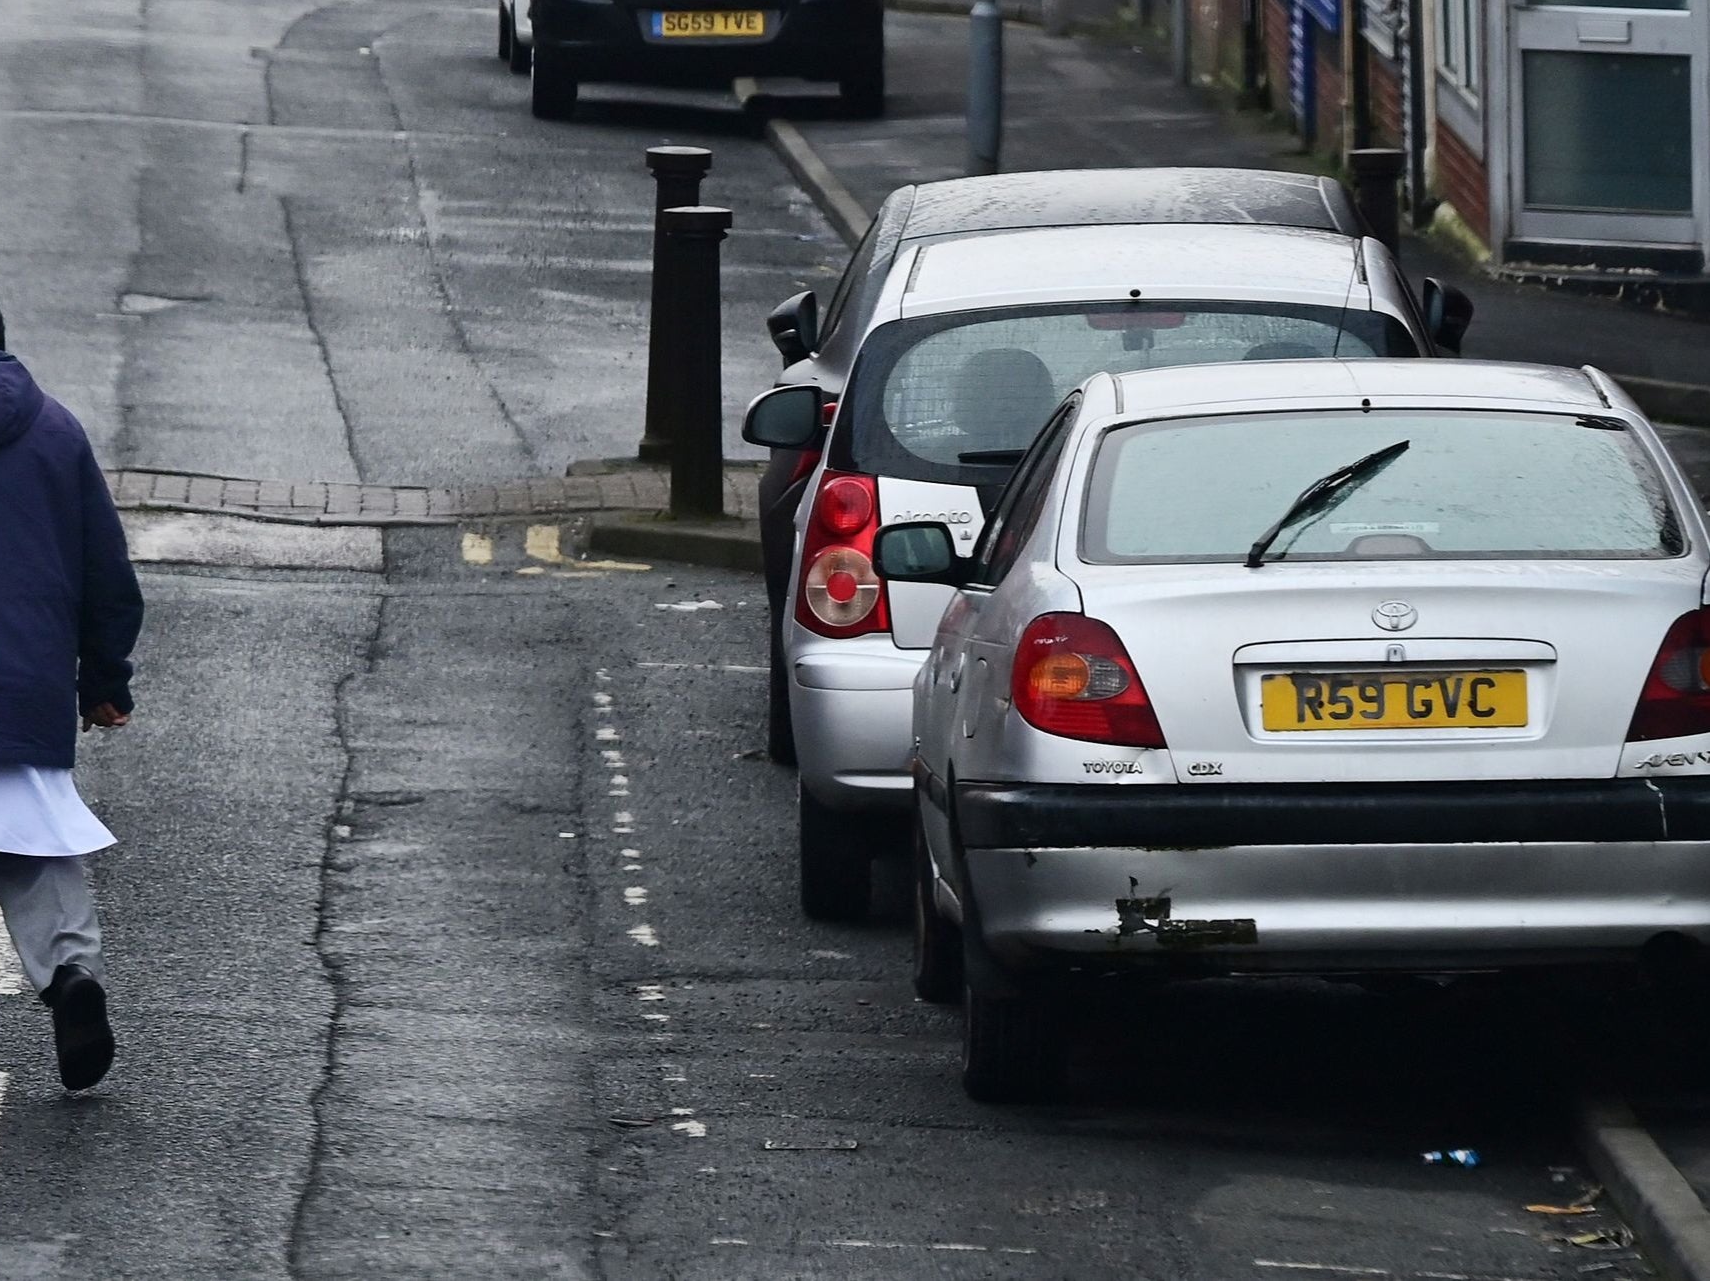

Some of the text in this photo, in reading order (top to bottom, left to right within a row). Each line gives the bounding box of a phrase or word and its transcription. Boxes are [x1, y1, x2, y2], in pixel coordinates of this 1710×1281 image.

[664, 12, 758, 31] SG59 TVE
[1294, 676, 1497, 723] R59 GVC
[1083, 761, 1143, 774] TOYOTA
